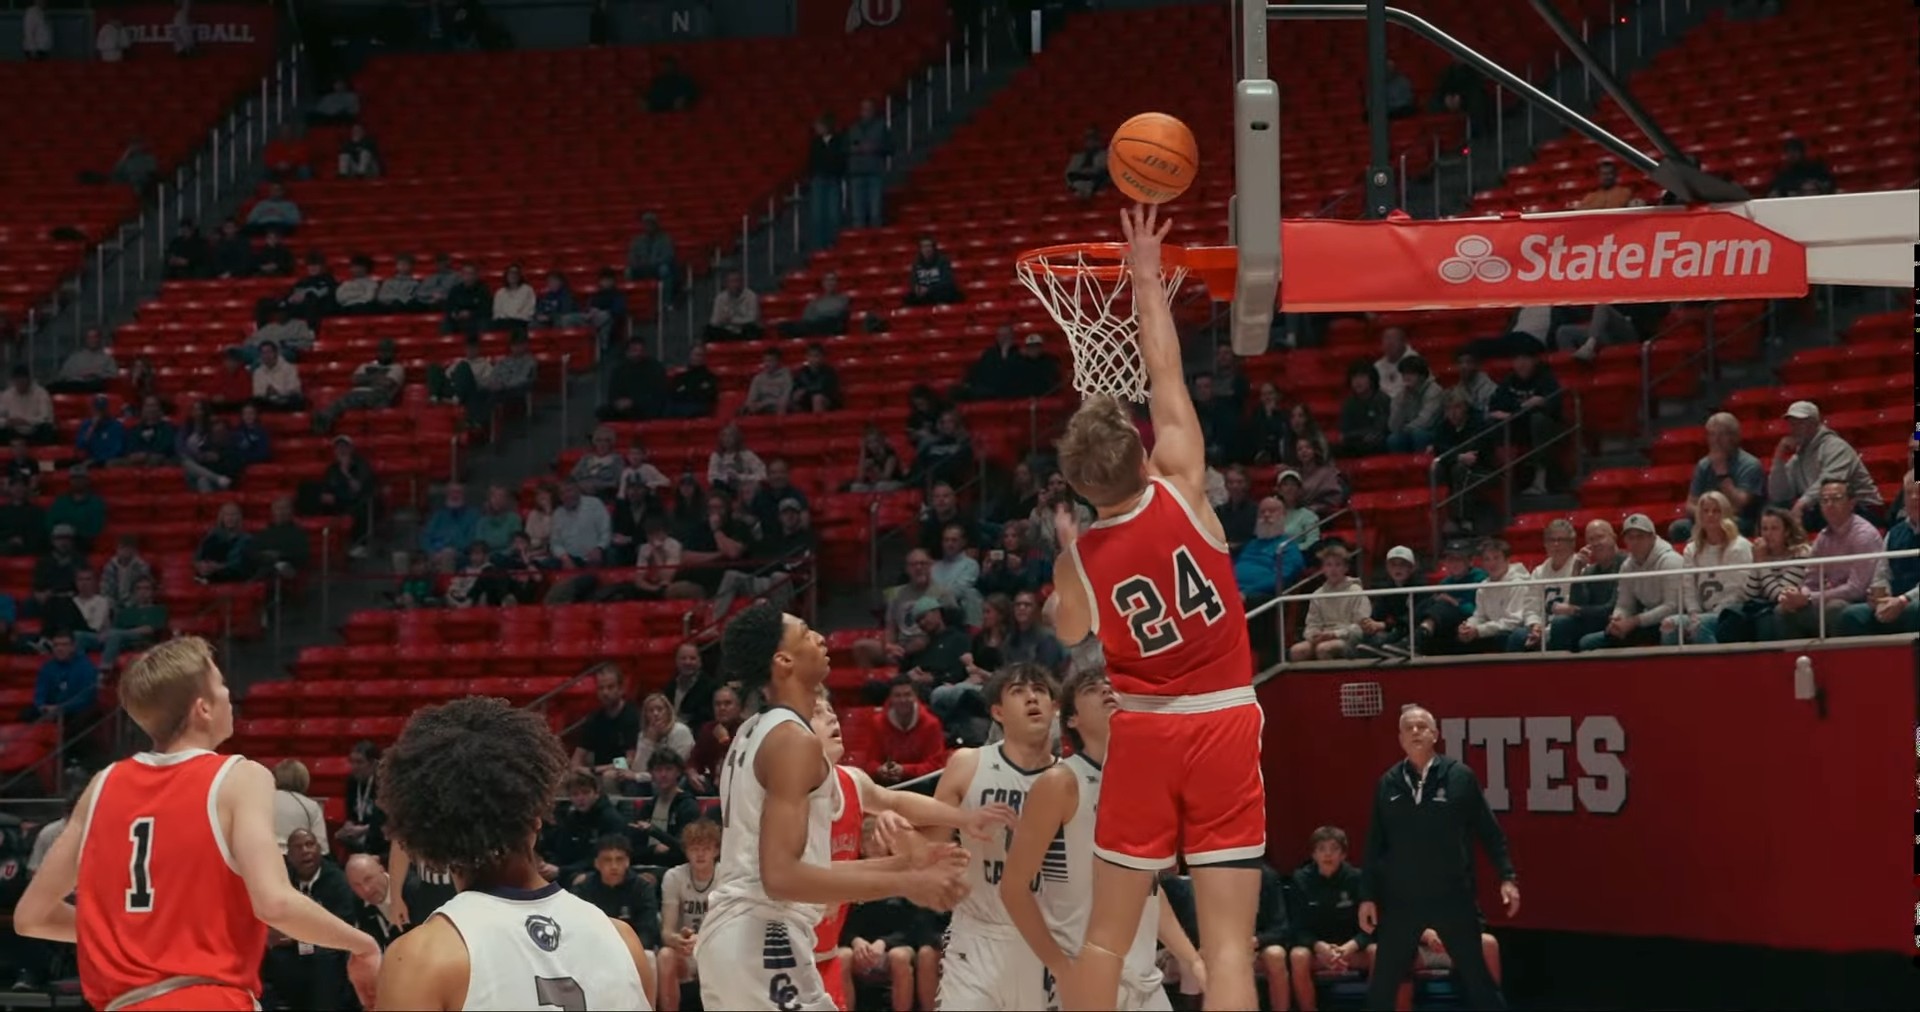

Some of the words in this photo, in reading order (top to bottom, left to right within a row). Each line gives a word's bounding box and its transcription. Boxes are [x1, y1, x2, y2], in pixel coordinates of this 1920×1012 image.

[672, 10, 690, 33] N
[1111, 545, 1226, 657] 24
[126, 816, 155, 913] 1
